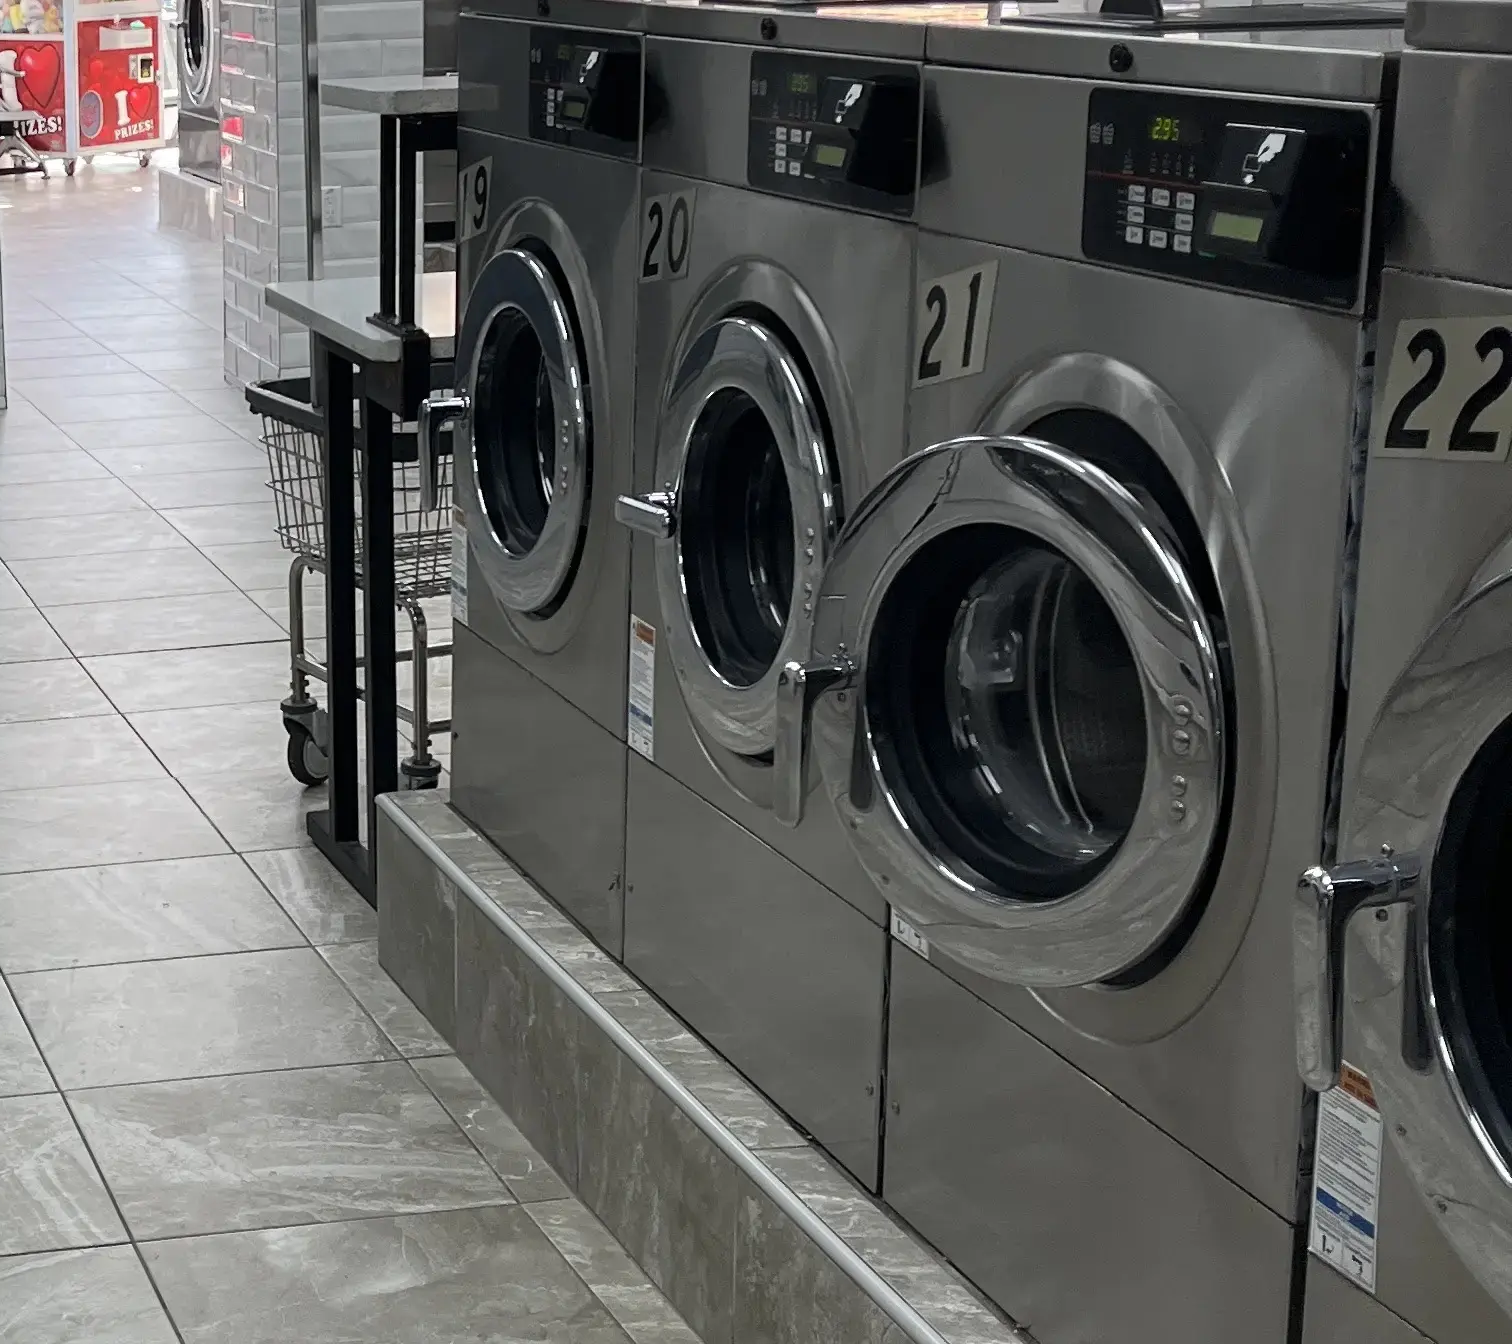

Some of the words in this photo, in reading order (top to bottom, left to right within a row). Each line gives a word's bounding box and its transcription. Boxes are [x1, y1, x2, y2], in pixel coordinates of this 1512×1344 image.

[113, 118, 155, 140] PRIZES!
[460, 165, 488, 238] 19
[642, 196, 689, 277] 20
[918, 271, 982, 380] 21
[1384, 327, 1512, 453] 22
